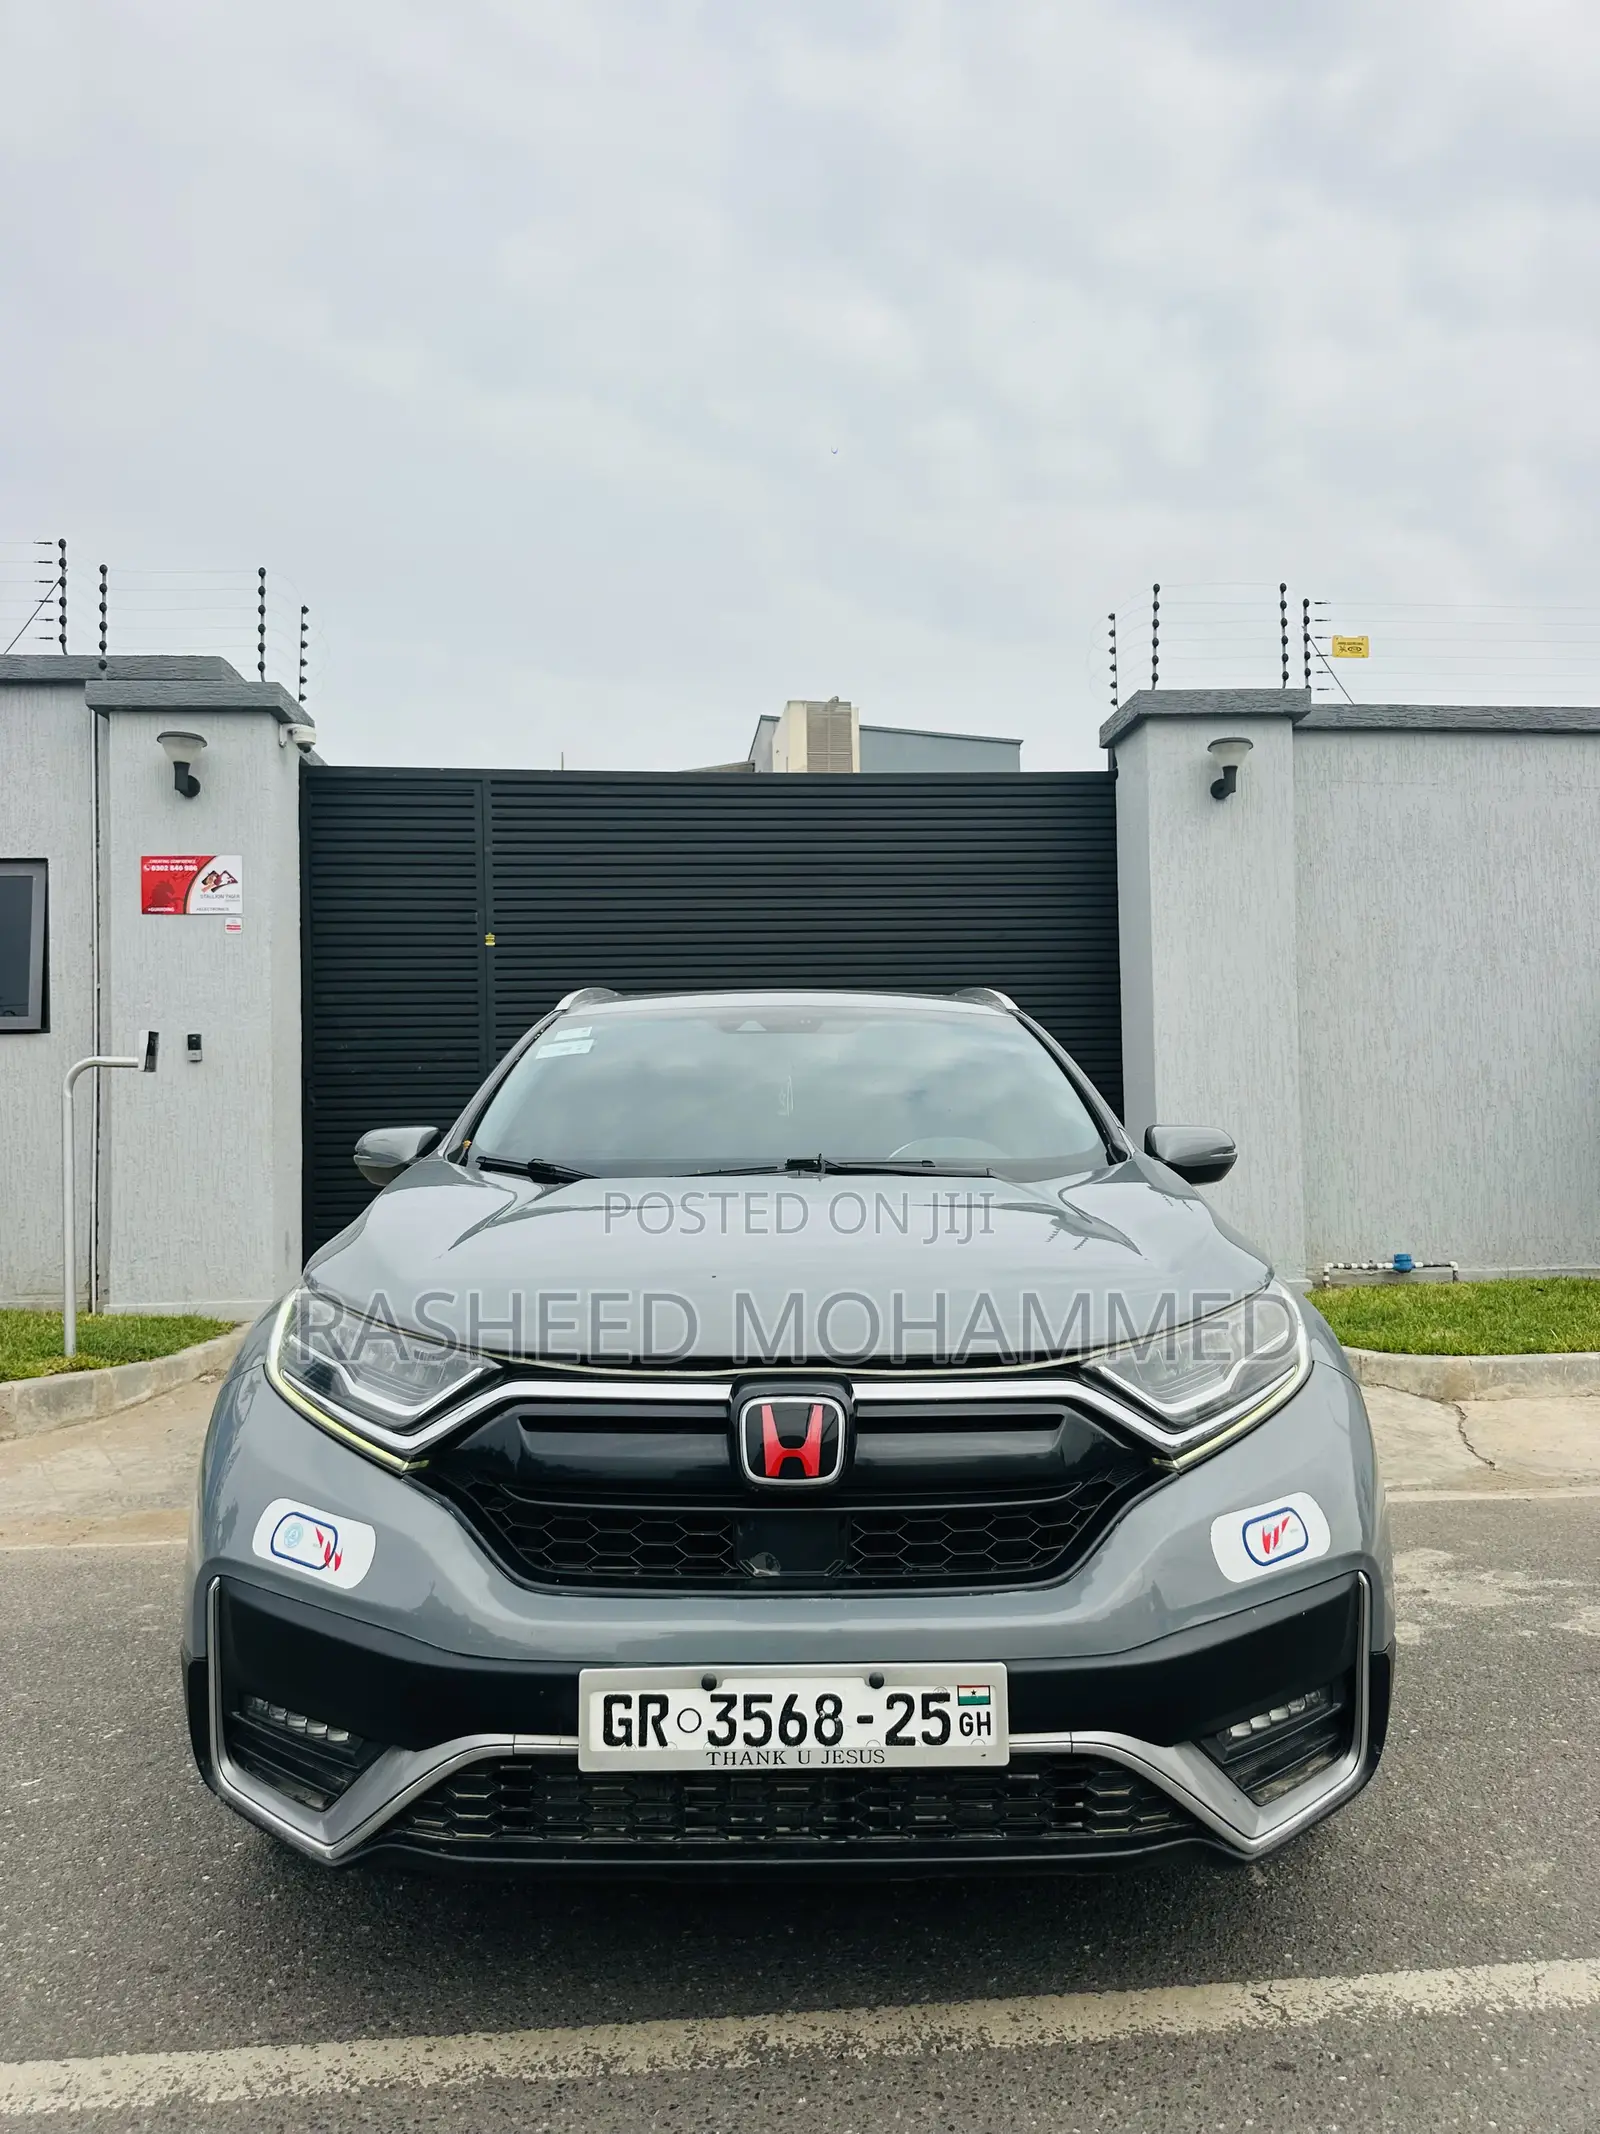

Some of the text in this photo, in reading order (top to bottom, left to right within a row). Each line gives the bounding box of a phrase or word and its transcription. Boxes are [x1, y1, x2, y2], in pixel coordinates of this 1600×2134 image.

[602, 1693, 669, 1747] GR
[958, 1711, 992, 1738] GH
[706, 1748, 886, 1767] THANK U JESUS
